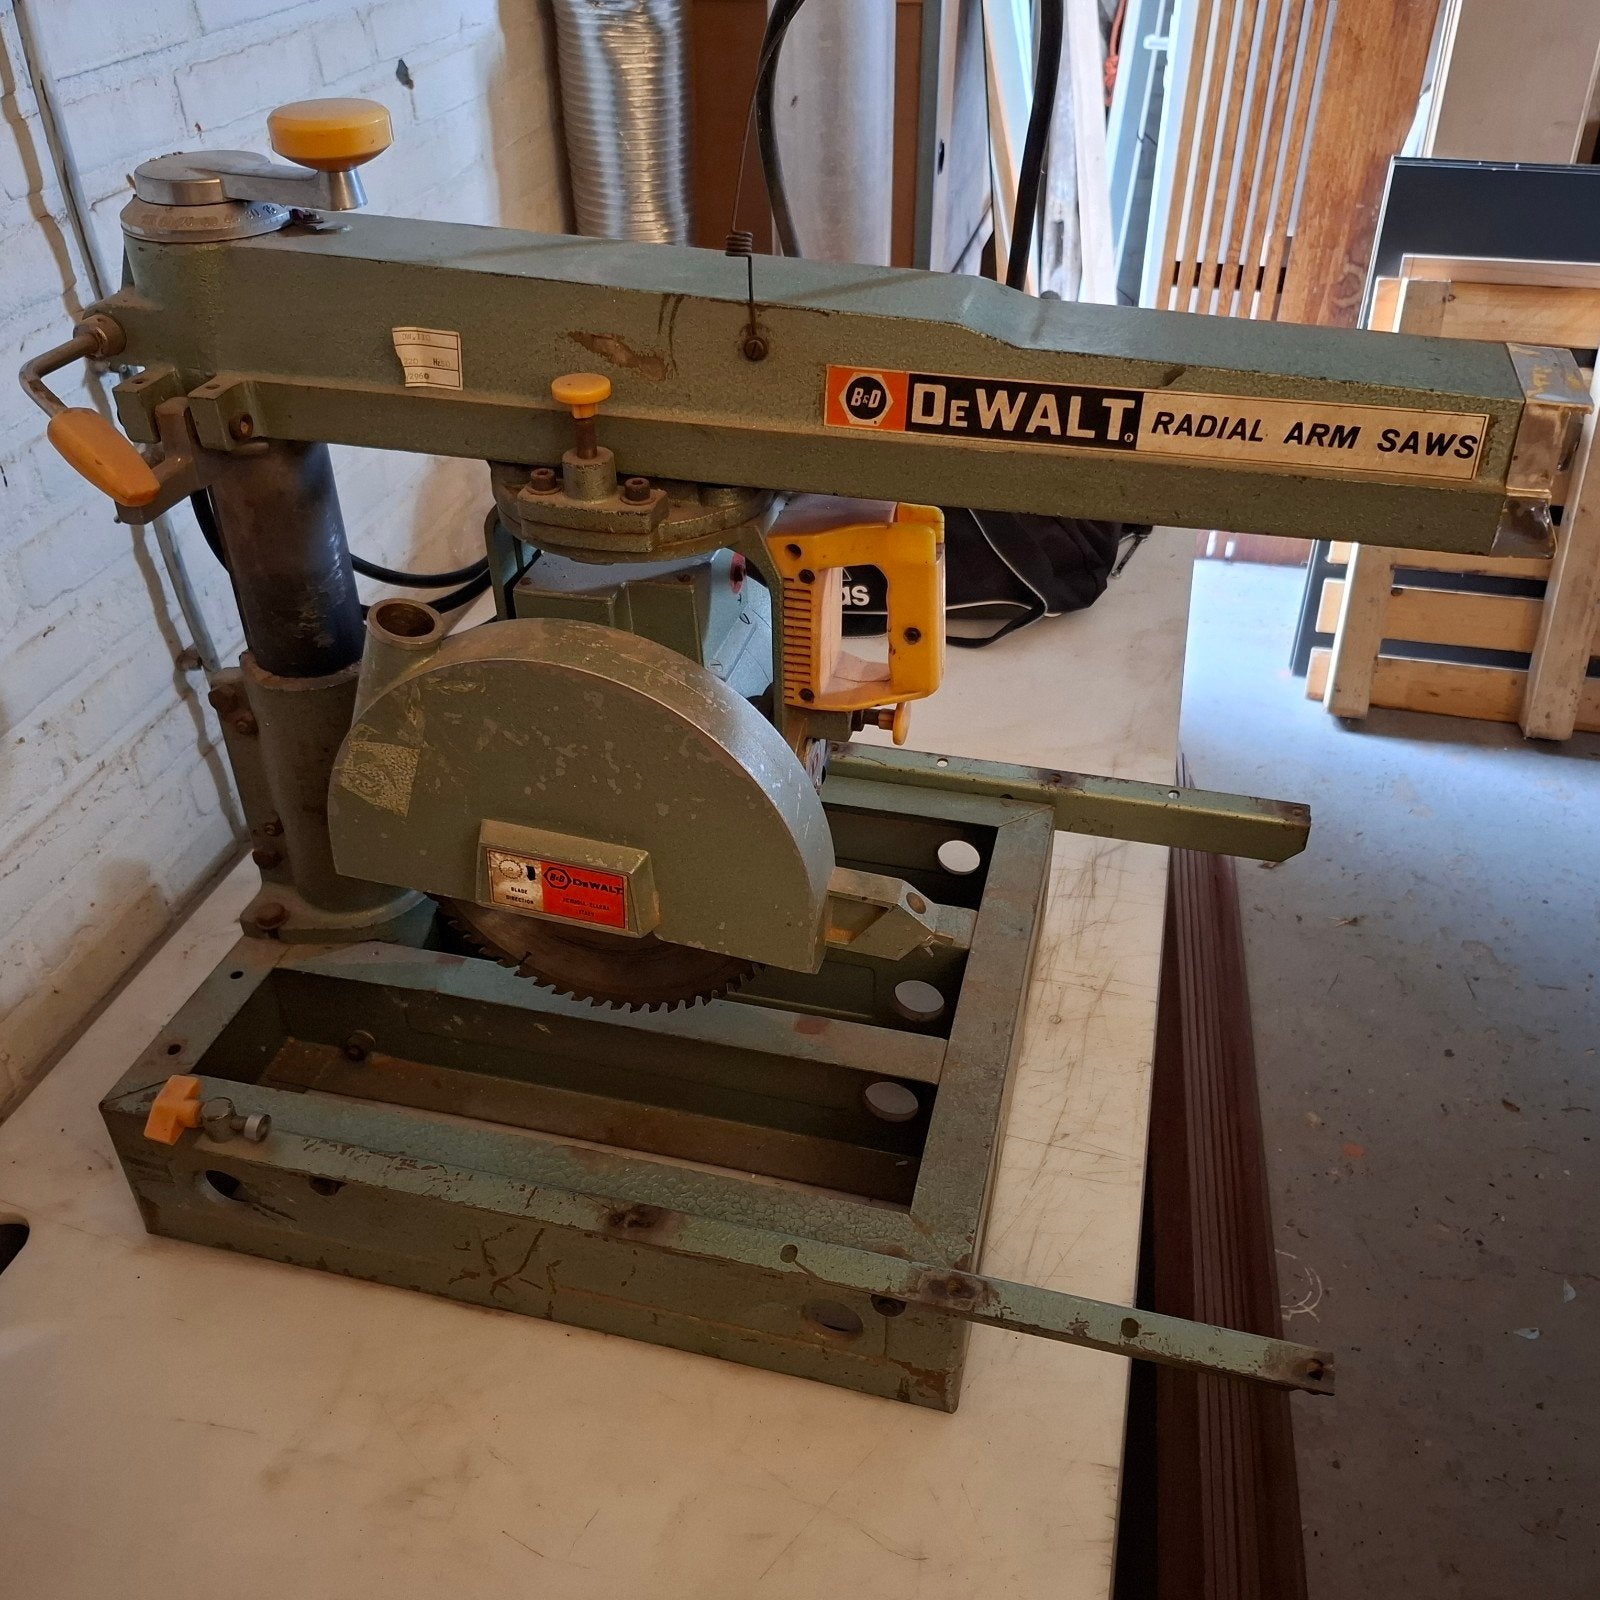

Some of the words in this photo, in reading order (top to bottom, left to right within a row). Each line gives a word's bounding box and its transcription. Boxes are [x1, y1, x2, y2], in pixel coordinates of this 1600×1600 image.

[850, 387, 882, 409] B&D
[1151, 411, 1265, 443] RADIAL
[1283, 421, 1361, 450] ARM
[1377, 428, 1478, 460] SAWS
[510, 886, 528, 895] BLADE
[505, 894, 534, 905] DIRECTION
